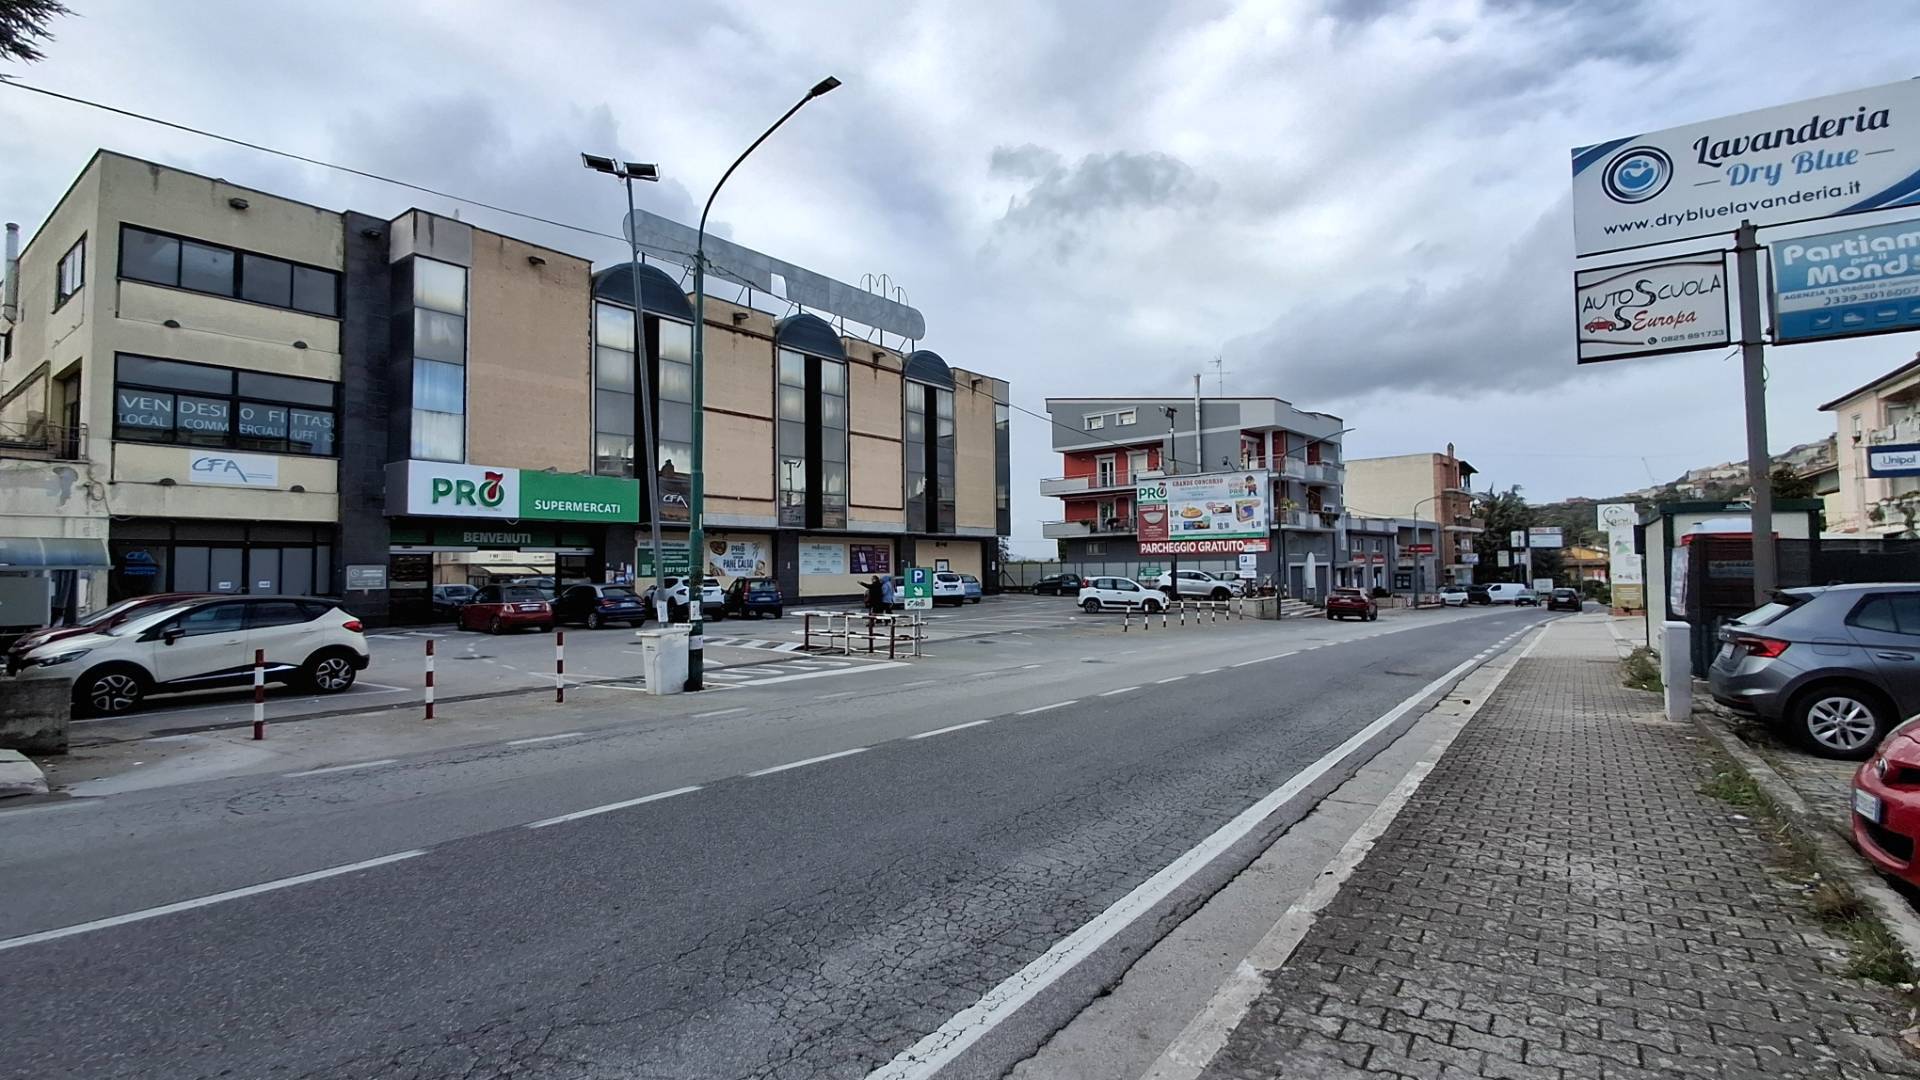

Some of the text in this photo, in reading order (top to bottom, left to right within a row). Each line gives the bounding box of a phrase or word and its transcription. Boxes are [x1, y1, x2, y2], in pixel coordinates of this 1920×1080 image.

[1693, 106, 1890, 167] Lavanderia
[1726, 149, 1859, 187] Dry Blue
[1603, 181, 1862, 235] www.drybluelavanderia.it
[1850, 255, 1874, 266] per
[1784, 289, 1825, 300] AGENZIA
[1840, 282, 1876, 293] VIAGGI
[1632, 310, 1697, 331] Europa
[1661, 335, 1685, 343] 0825
[1882, 455, 1916, 465] Unipol
[192, 456, 247, 482] CFA
[535, 500, 621, 513] SUPERMERCATI
[663, 493, 688, 508] CFA
[463, 532, 531, 544] BENVENUTI
[1141, 542, 1196, 553] PARCHEGGIO
[1198, 540, 1244, 552] GRATUITO
[723, 559, 754, 569] PANE CALDO
